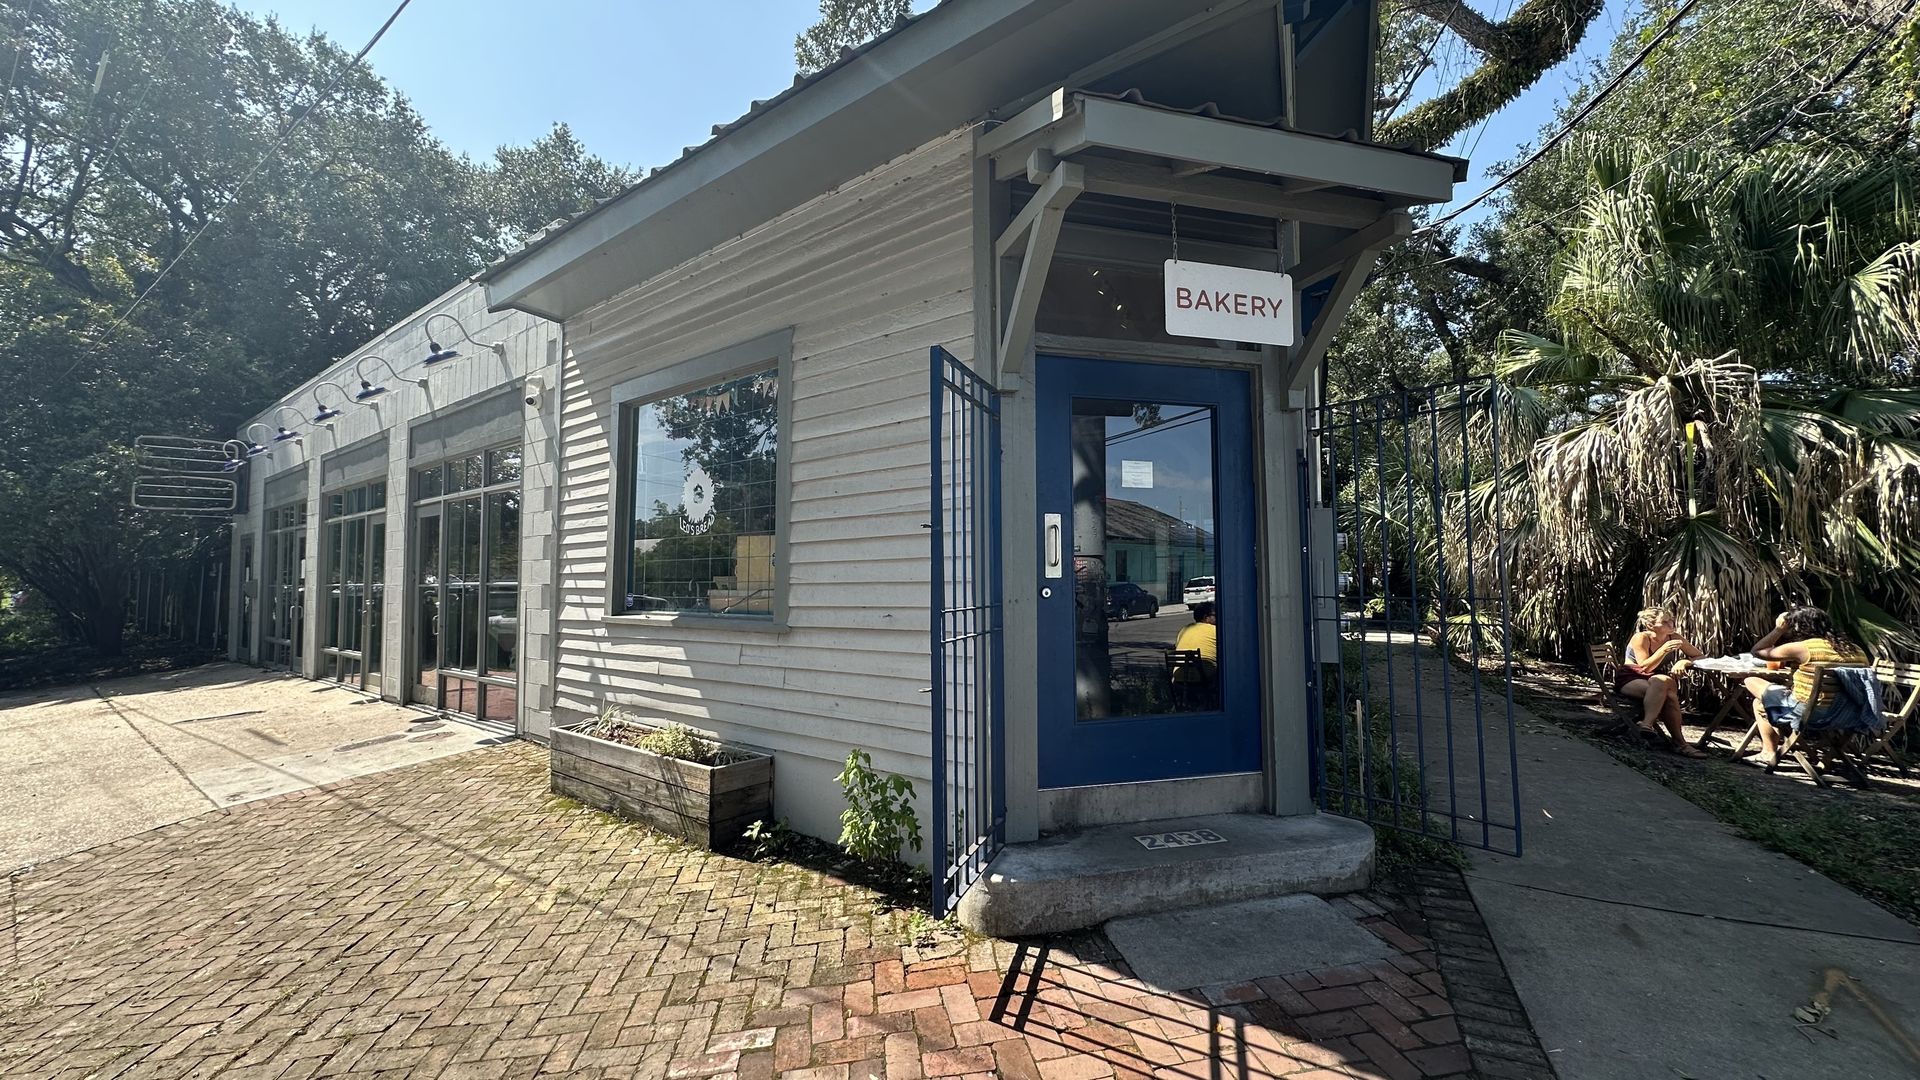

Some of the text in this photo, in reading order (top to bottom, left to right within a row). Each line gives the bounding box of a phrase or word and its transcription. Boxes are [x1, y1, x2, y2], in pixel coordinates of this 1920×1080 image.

[1176, 287, 1283, 319] BAKERY
[695, 513, 715, 536] BREAD
[1140, 830, 1222, 848] 2438
